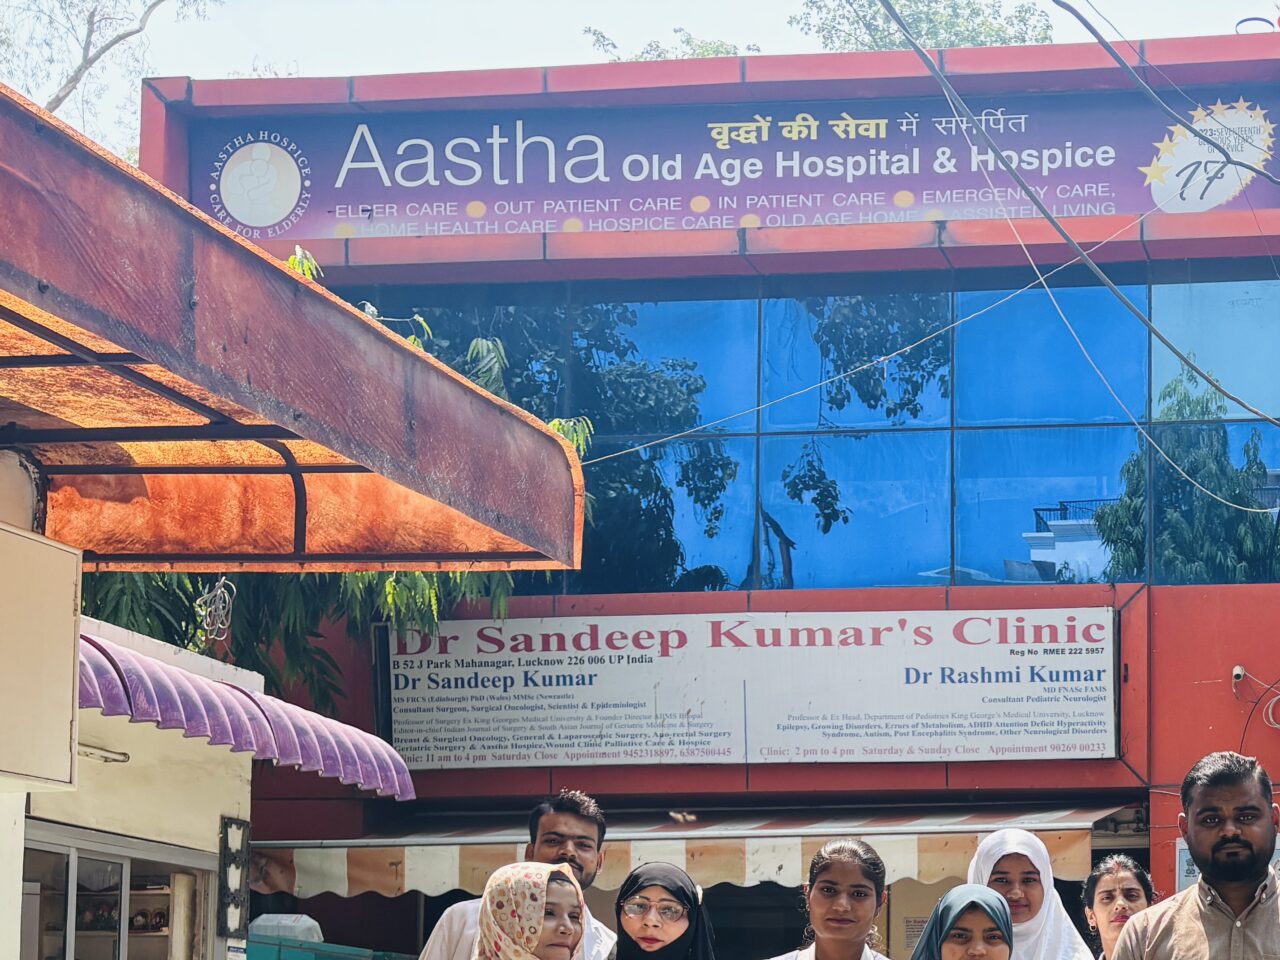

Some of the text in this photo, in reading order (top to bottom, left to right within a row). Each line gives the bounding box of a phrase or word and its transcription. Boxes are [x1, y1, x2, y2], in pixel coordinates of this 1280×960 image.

[707, 114, 773, 149] वृद्धों
[778, 113, 820, 141] की
[828, 112, 888, 140] सेवा
[896, 112, 920, 137] में
[210, 130, 311, 180] AASTHA HOSPICE
[334, 119, 1116, 189] Aastha Old Age Hospital & Hospice
[1176, 160, 1225, 201] 17
[335, 183, 1116, 218] ELDER CARE OUT PATIENT CARE IN PATIENT CARE EMERGENCY CARE,
[209, 190, 311, 239] CARE FOR ELDERLY
[361, 202, 1116, 236] HOME HEALTH CARE HOSPICE CARE OLD AGE HOME LIVING
[393, 616, 1106, 658] Dr Sandeep Kumar's Clinic
[392, 660, 400, 670] B
[402, 660, 414, 670] 52
[417, 660, 423, 670] J
[426, 660, 451, 669] Park
[517, 657, 564, 667] Lucknow
[567, 656, 585, 666] 226
[587, 655, 606, 665] 006
[608, 655, 624, 665] UP
[627, 654, 654, 665] India
[1009, 649, 1025, 657] Reg
[1085, 647, 1105, 655] 5957
[393, 670, 598, 693] Dr Sandeep Kumar
[904, 665, 1107, 685] Dr Rashmi Kumar
[393, 706, 434, 714] Consultant
[471, 704, 503, 713] Surgical
[1026, 695, 1060, 703] Pediatric
[1062, 694, 1107, 703] Neurologist
[605, 740, 643, 748] Palliative
[678, 739, 712, 747] Hospice
[698, 730, 732, 738] Surgery
[427, 753, 434, 762] 11
[454, 754, 463, 762] to
[464, 753, 470, 761] 4
[472, 754, 487, 763] pm
[491, 751, 531, 762] Saturday
[534, 751, 559, 760] Close
[563, 750, 621, 761] Appointment
[795, 746, 800, 756] 2
[803, 748, 818, 758] pm
[820, 747, 830, 756] to
[831, 746, 838, 755] 4
[840, 748, 855, 758] pm
[862, 745, 904, 756] Saturday
[906, 745, 916, 754] &
[918, 744, 953, 756] Sunday
[955, 745, 980, 754] Close
[988, 743, 1047, 755] Appointment
